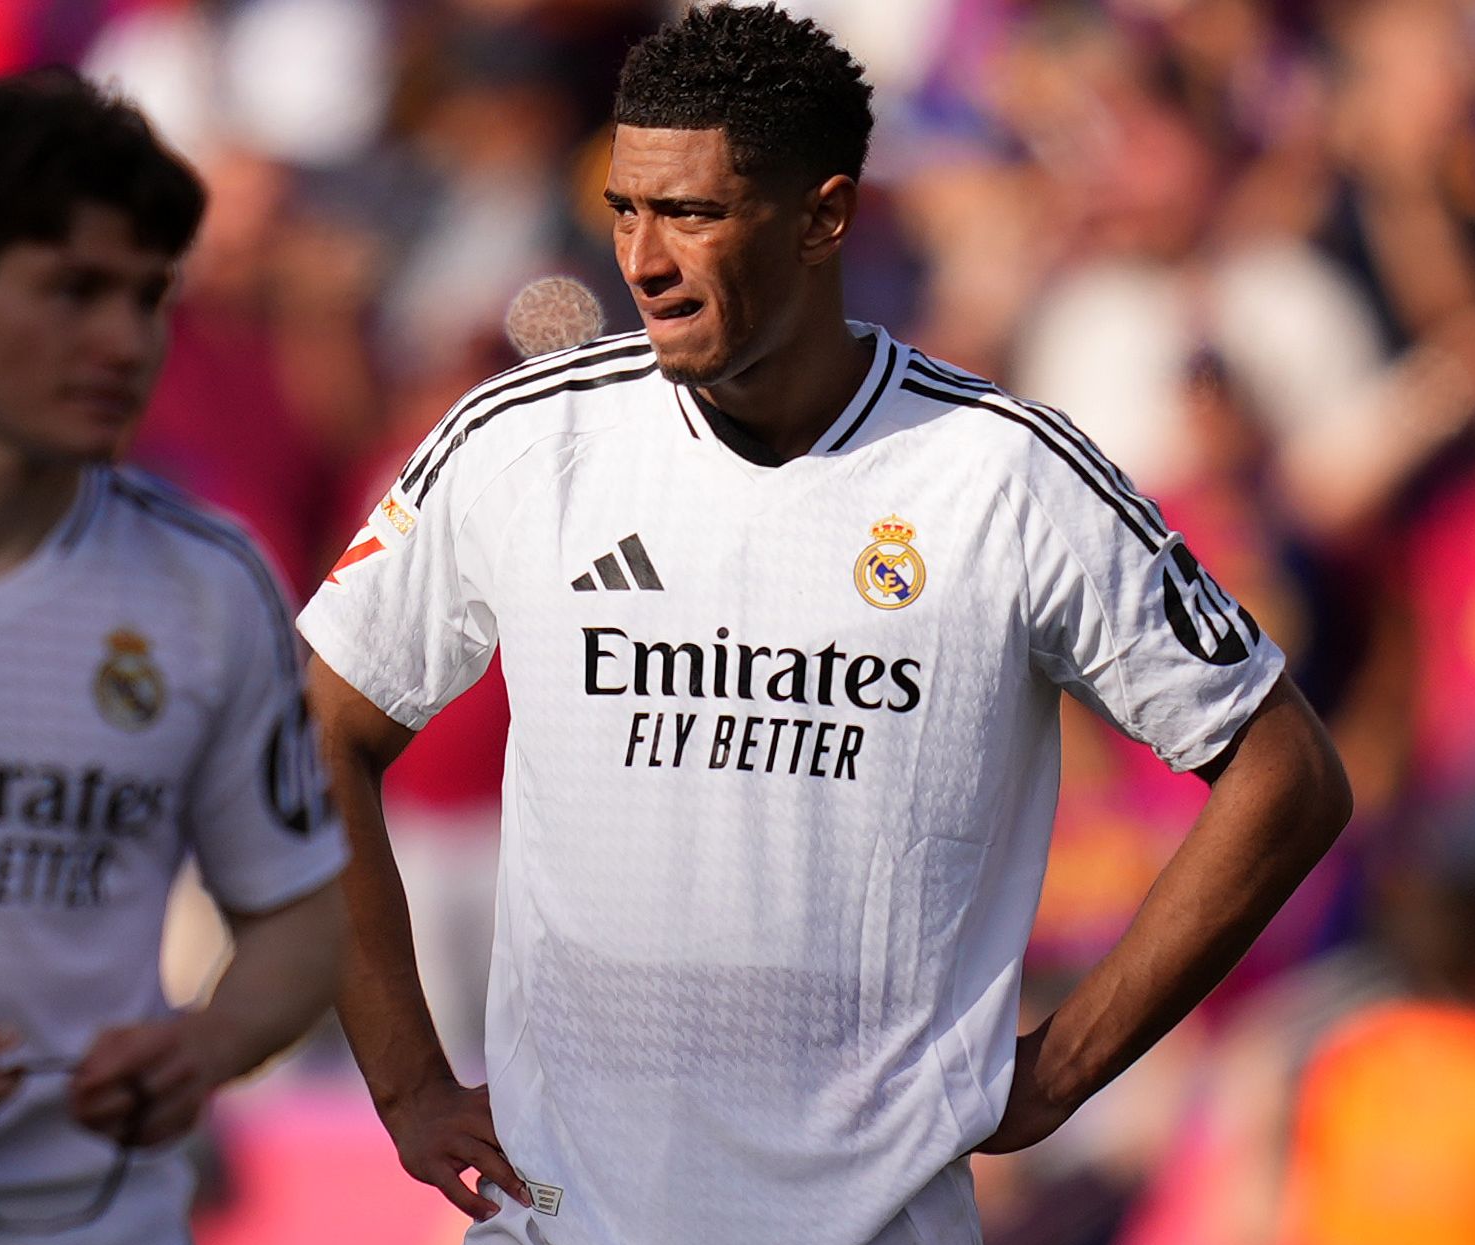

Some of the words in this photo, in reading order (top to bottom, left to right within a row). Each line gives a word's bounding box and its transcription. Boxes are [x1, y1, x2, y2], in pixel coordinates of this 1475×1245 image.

[581, 626, 921, 713] Emirates
[625, 712, 697, 768] FLY
[708, 714, 865, 780] BETTER
